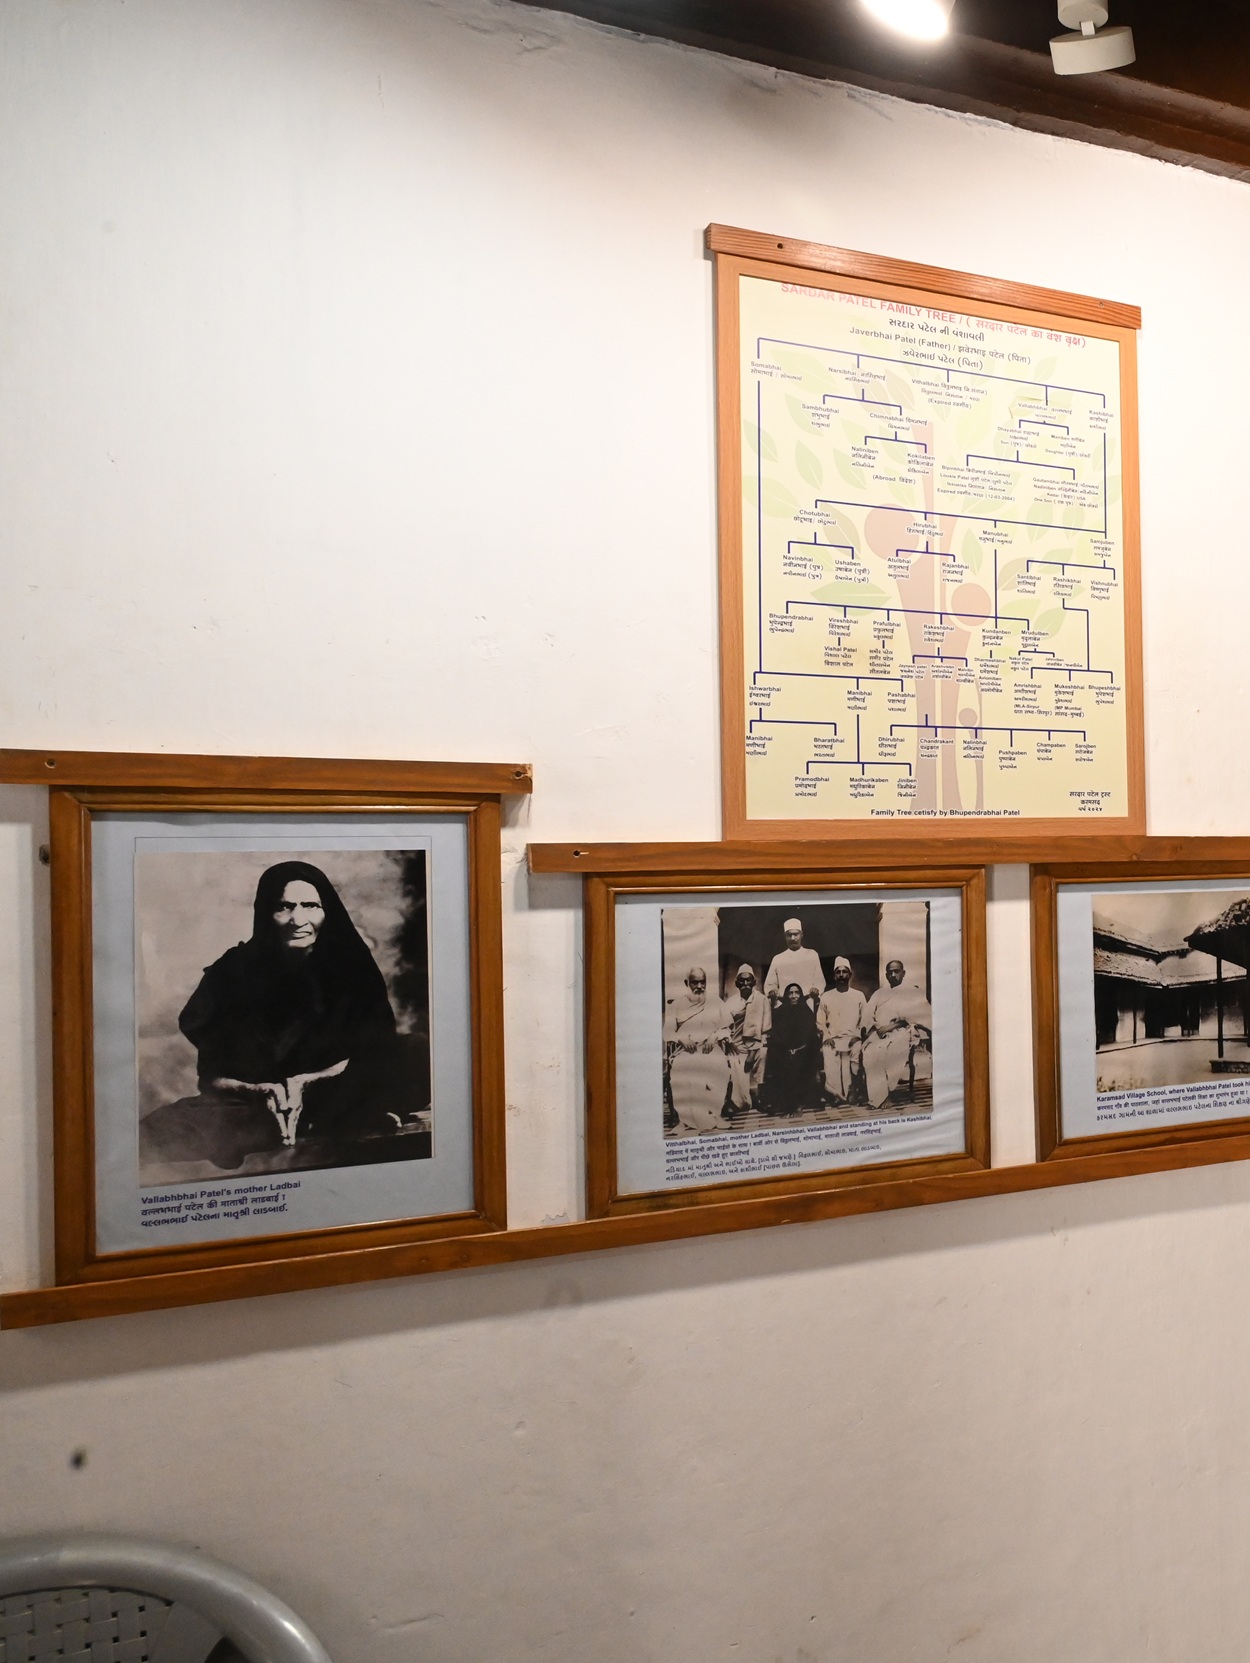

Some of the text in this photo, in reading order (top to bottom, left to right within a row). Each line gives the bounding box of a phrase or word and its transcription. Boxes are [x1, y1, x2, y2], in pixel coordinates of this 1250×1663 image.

[781, 283, 835, 301] SARDAR
[839, 294, 876, 309] PATEL
[880, 300, 922, 317] FAMILY
[926, 310, 956, 323] TREE
[888, 318, 915, 330] સરદાર
[918, 322, 937, 333] પટેલ
[940, 325, 949, 335] ની
[976, 319, 1003, 332] सरदार
[850, 326, 892, 340] Javerbhai
[895, 334, 916, 344] Patel
[918, 338, 951, 352] (Father)
[938, 354, 955, 364] પટેલ
[989, 349, 1005, 360] पटेल
[799, 509, 831, 518] Chotubhai
[769, 613, 814, 622] Bhupendrabhai
[871, 809, 894, 817] Family
[914, 809, 938, 817] cetisfy
[939, 809, 947, 817] by
[1097, 1094, 1125, 1102] Karamsad
[1146, 1089, 1167, 1097] School,
[1187, 1083, 1217, 1093] Vallabhbhai
[1233, 1080, 1244, 1088] took
[730, 1133, 749, 1141] mother
[808, 1124, 838, 1133] Vallabhbhai
[850, 1120, 872, 1129] standing
[142, 1181, 301, 1205] Vallabhbhai Patel's mother Ladbai
[185, 1202, 204, 1211] पटेल
[207, 1199, 217, 1209] की
[191, 1212, 220, 1222] પટેલના
